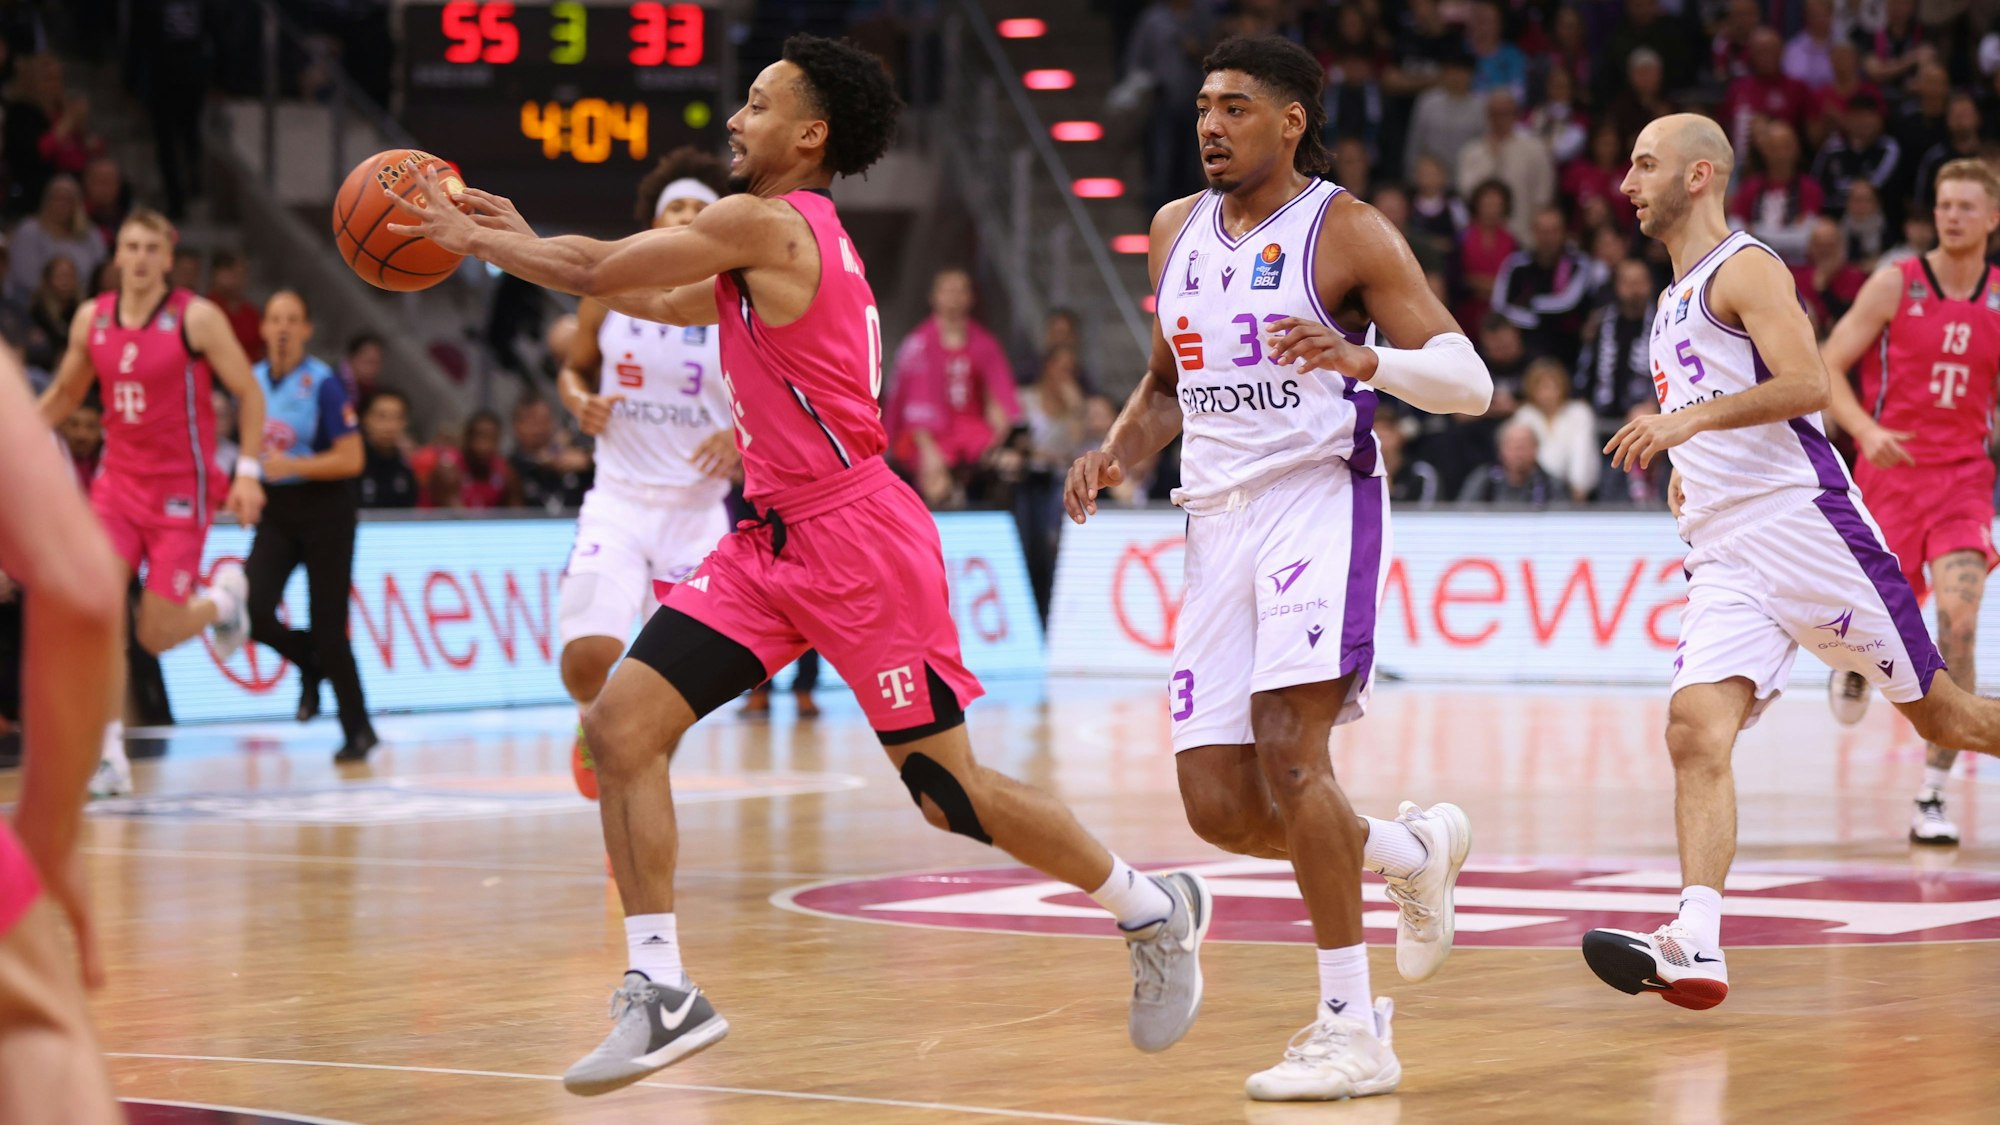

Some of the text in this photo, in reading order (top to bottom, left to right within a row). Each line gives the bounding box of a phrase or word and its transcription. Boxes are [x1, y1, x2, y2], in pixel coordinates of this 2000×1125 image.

[442, 1, 520, 64] 55
[551, 2, 587, 64] 3
[629, 2, 704, 66] 33
[521, 98, 649, 163] 4:04
[1253, 276, 1277, 287] BBL
[119, 341, 139, 374] 2
[1675, 338, 1705, 385] 5
[1942, 321, 1972, 355] 13
[680, 361, 704, 396] 3
[1182, 380, 1301, 413] SARTORIUS
[345, 570, 567, 672] mew
[1380, 556, 1691, 650] ewa
[877, 664, 915, 709] T
[1168, 669, 1195, 722] 3
